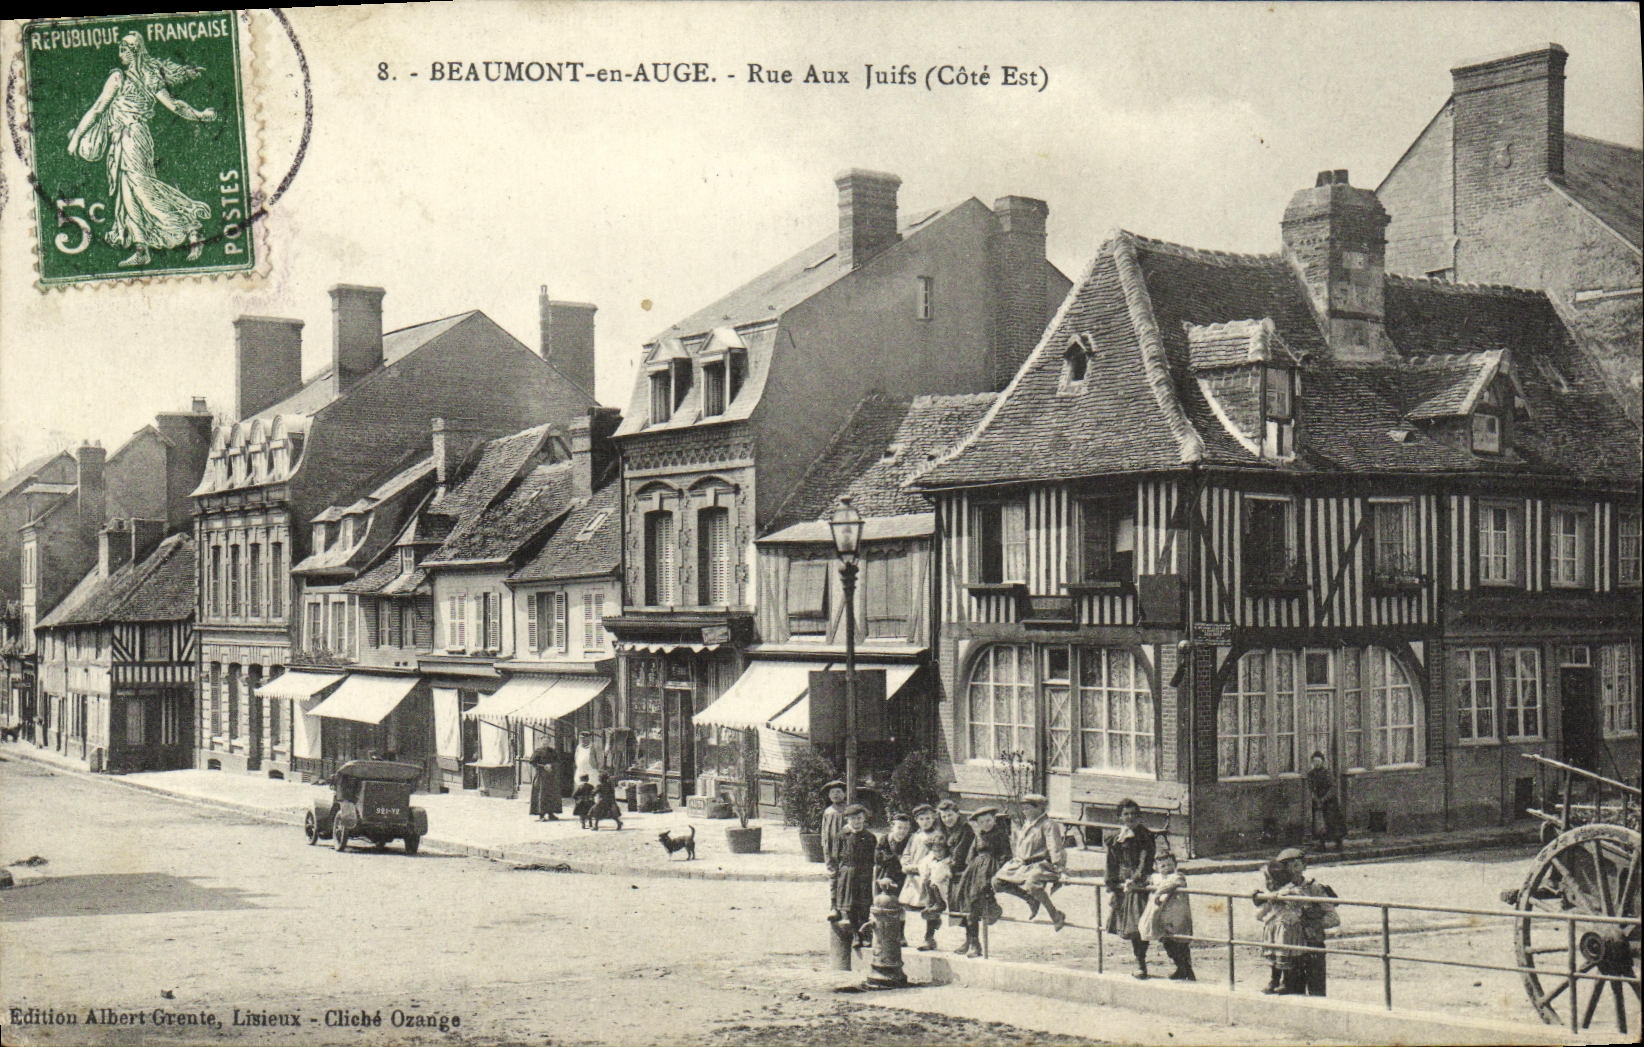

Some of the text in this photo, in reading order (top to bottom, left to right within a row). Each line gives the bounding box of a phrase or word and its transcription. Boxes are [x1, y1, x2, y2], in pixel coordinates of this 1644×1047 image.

[30, 18, 230, 51] REPUBLIQUE FRANÇAISE
[219, 168, 244, 256] POSTES
